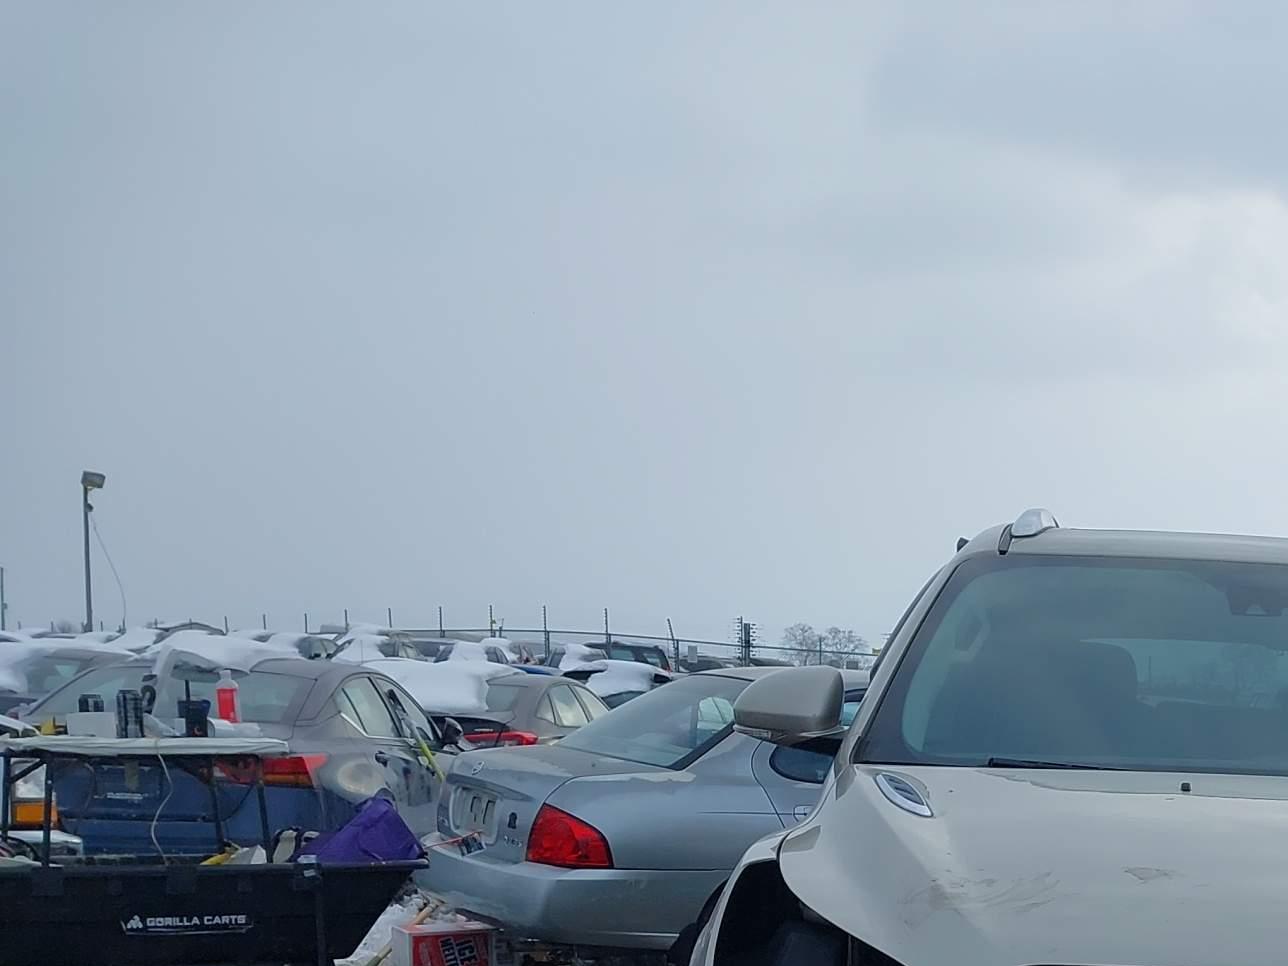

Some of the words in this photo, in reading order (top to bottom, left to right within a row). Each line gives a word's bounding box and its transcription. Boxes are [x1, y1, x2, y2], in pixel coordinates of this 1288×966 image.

[146, 916, 200, 927] GORILLA
[203, 915, 247, 925] CARTS
[455, 940, 477, 966] ICE
